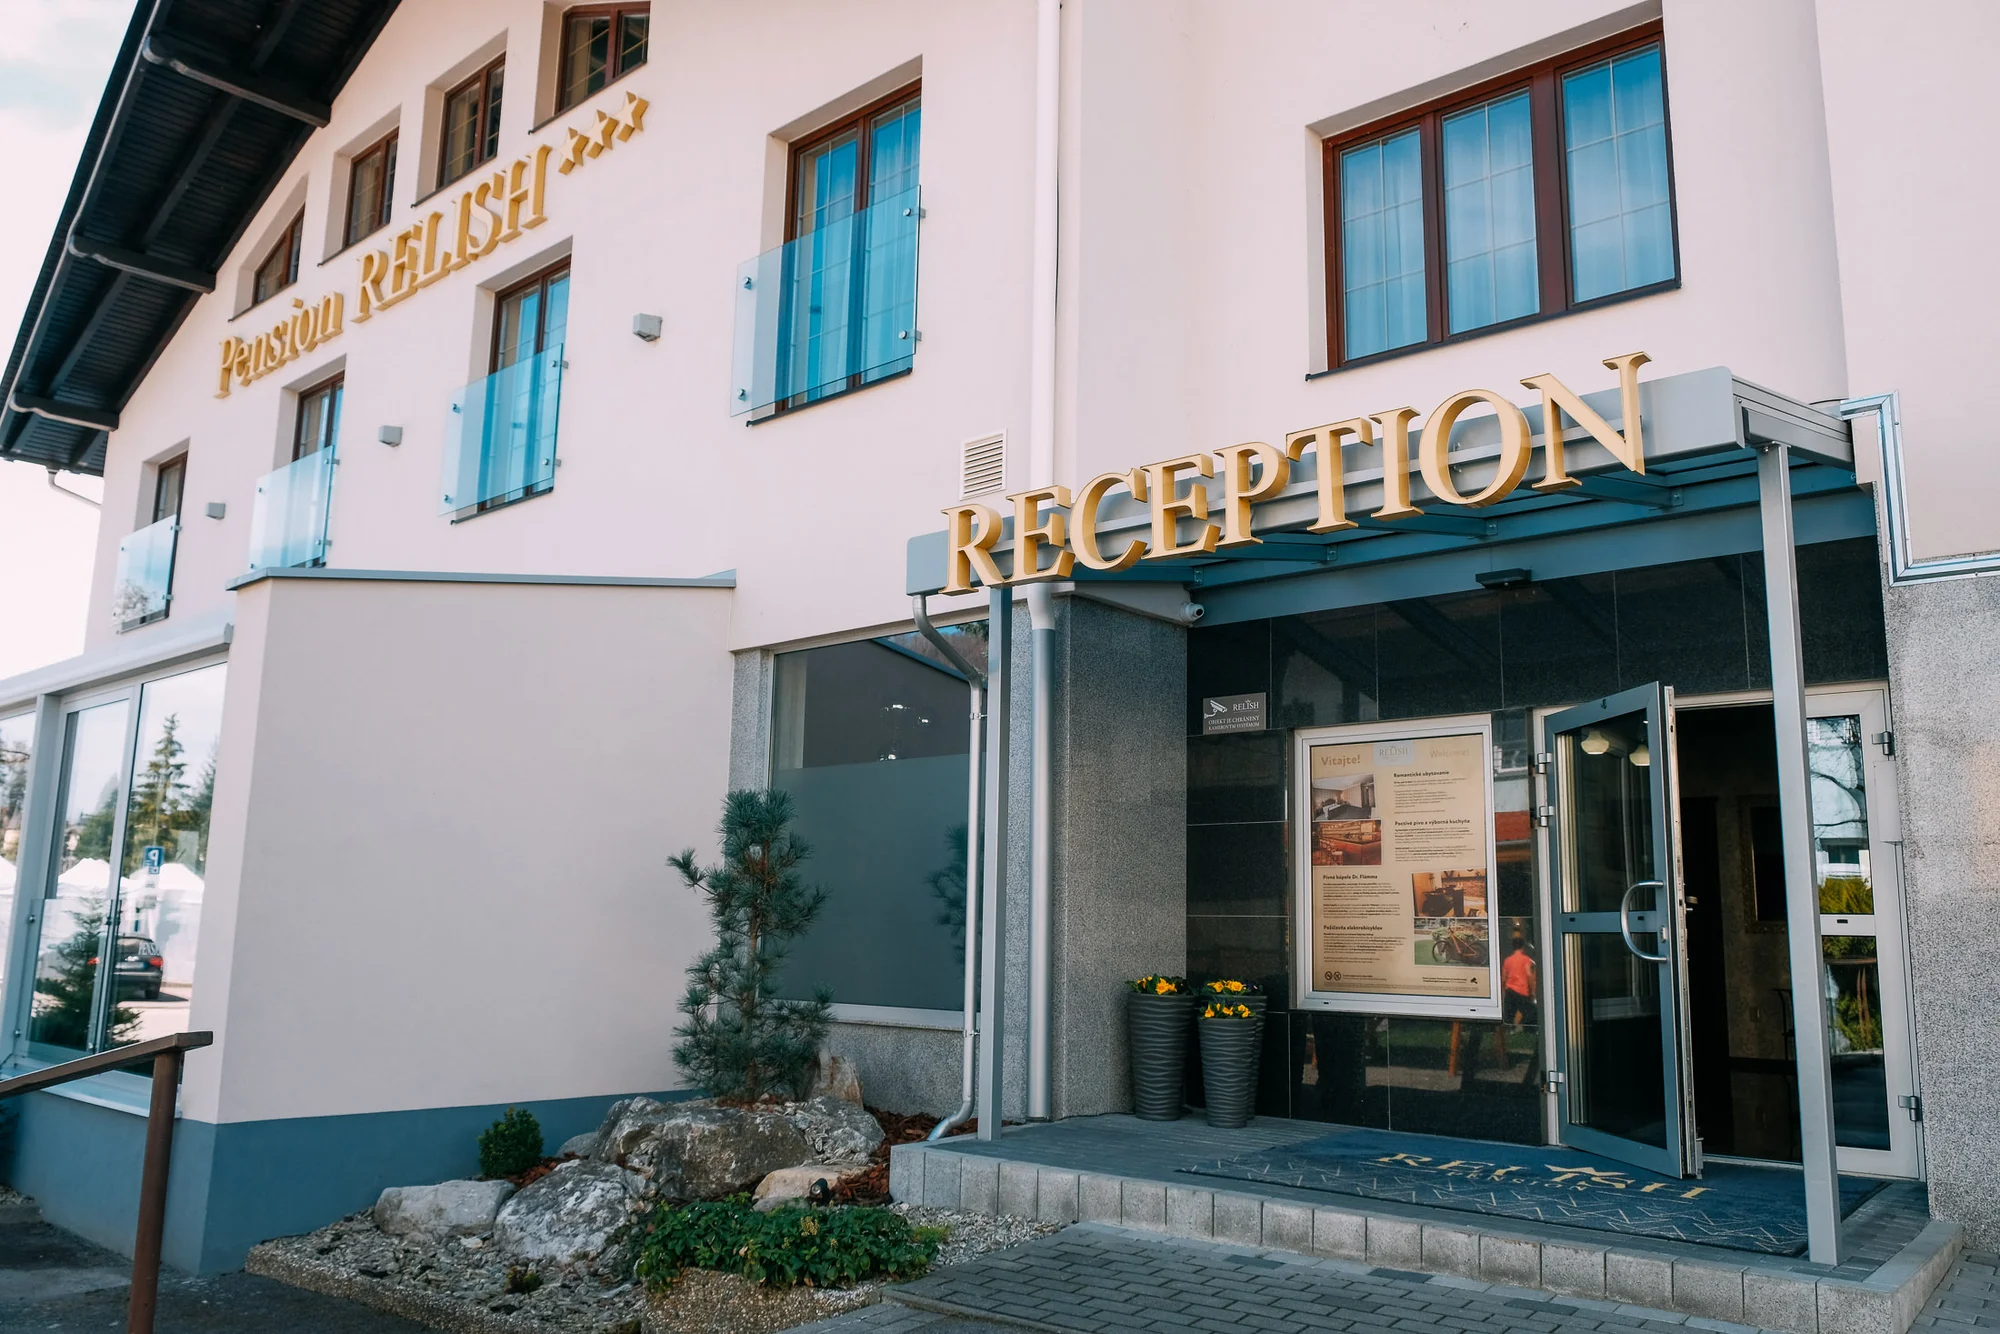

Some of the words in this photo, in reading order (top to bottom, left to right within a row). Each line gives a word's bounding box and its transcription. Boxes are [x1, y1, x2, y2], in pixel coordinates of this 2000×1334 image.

[213, 291, 344, 399] Pension
[350, 144, 553, 324] RELISH
[938, 351, 1652, 596] RECEPTION
[1233, 702, 1259, 711] RELISH
[1380, 747, 1408, 756] RELISH
[1430, 748, 1470, 758] Welcome!
[1321, 754, 1361, 767] Vitajte!
[1375, 1152, 1715, 1199] RELISH
[1447, 1171, 1588, 1191] PENSION
